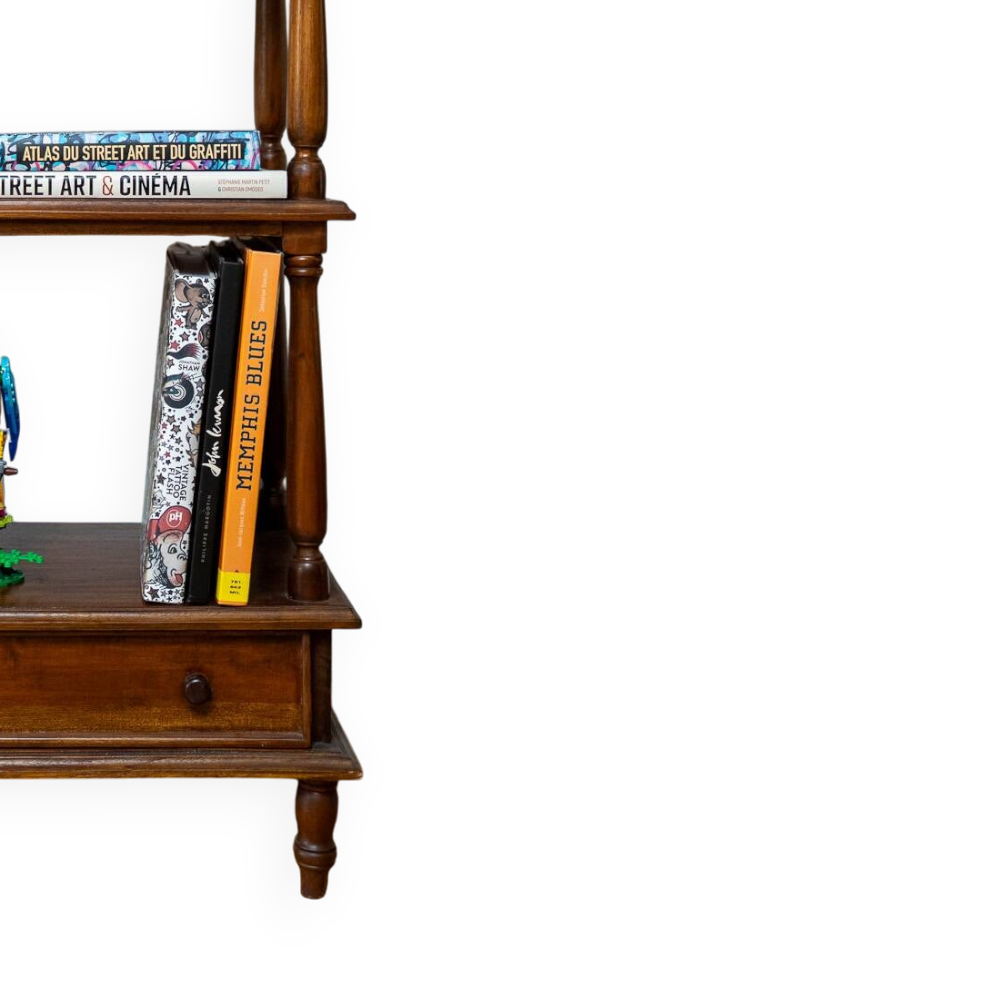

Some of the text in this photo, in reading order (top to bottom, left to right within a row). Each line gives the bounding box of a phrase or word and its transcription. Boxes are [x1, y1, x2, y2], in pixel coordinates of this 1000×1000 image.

[23, 143, 242, 162] ATLAS DU STREET ART ET DU GRAFFITI
[61, 175, 97, 196] ART
[102, 175, 114, 196] &
[119, 171, 191, 196] CINÉMA
[246, 320, 267, 387] BLUES
[236, 395, 261, 491] MEMPHIS
[166, 467, 175, 495] FLASH
[173, 467, 182, 498] TATTOO
[180, 464, 189, 501] VINTAGE
